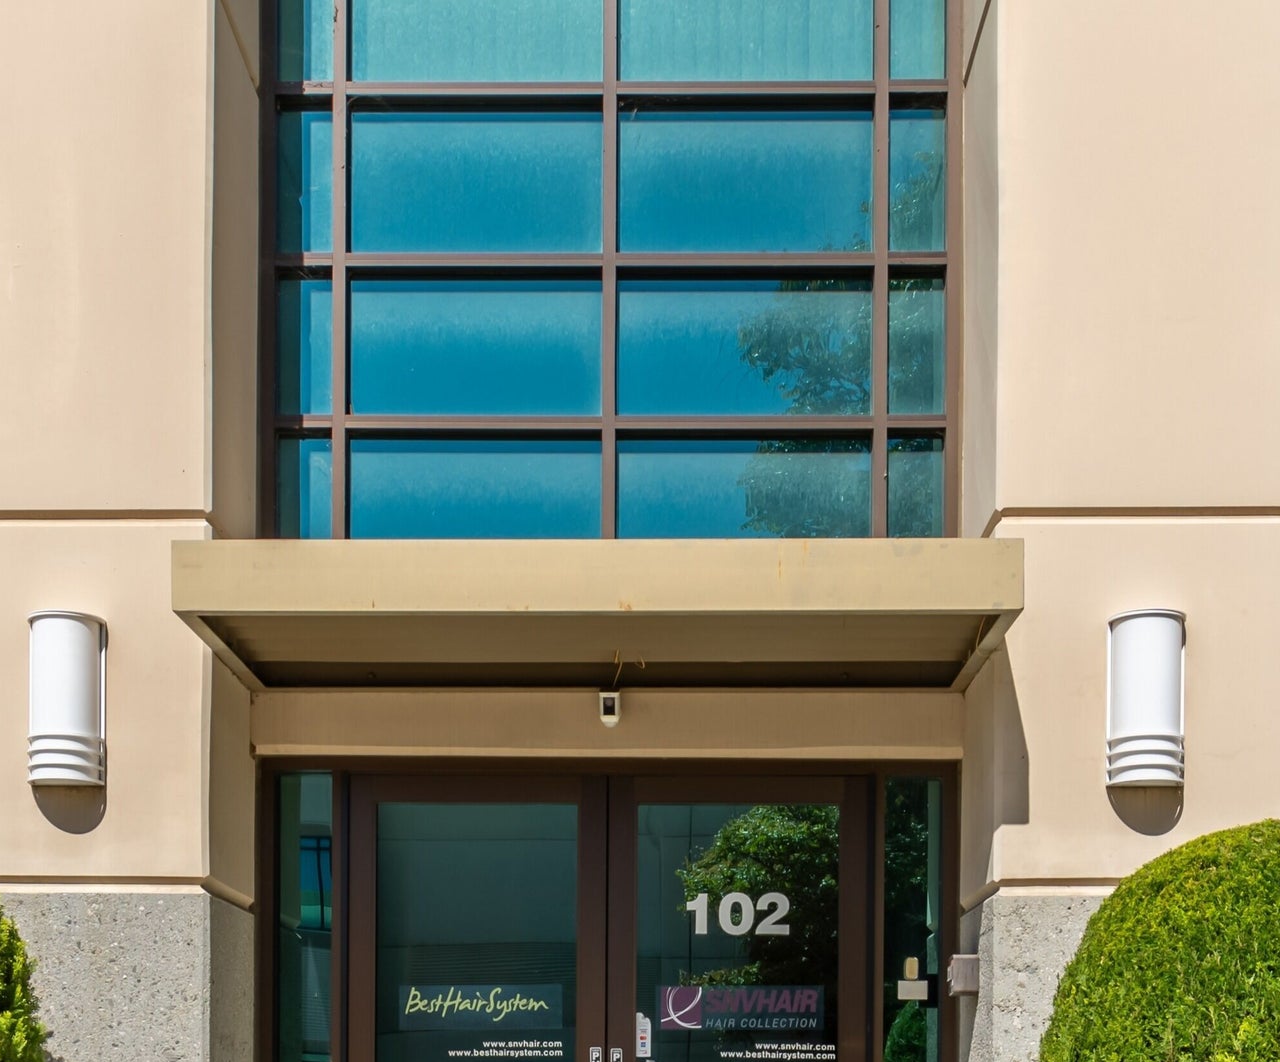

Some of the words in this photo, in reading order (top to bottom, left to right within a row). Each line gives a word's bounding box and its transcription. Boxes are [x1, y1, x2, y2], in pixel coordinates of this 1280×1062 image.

[686, 892, 790, 936] 102
[405, 986, 550, 1022] BestHairSystem
[705, 1018, 736, 1028] HAIR
[740, 1018, 817, 1028] COLLECTION
[483, 1040, 563, 1048] www.snvhair.com
[755, 1042, 836, 1051] www.snvhair.com
[448, 1048, 563, 1058] www.besthairsystem.com
[720, 1050, 836, 1060] www.besthairsystem.com
